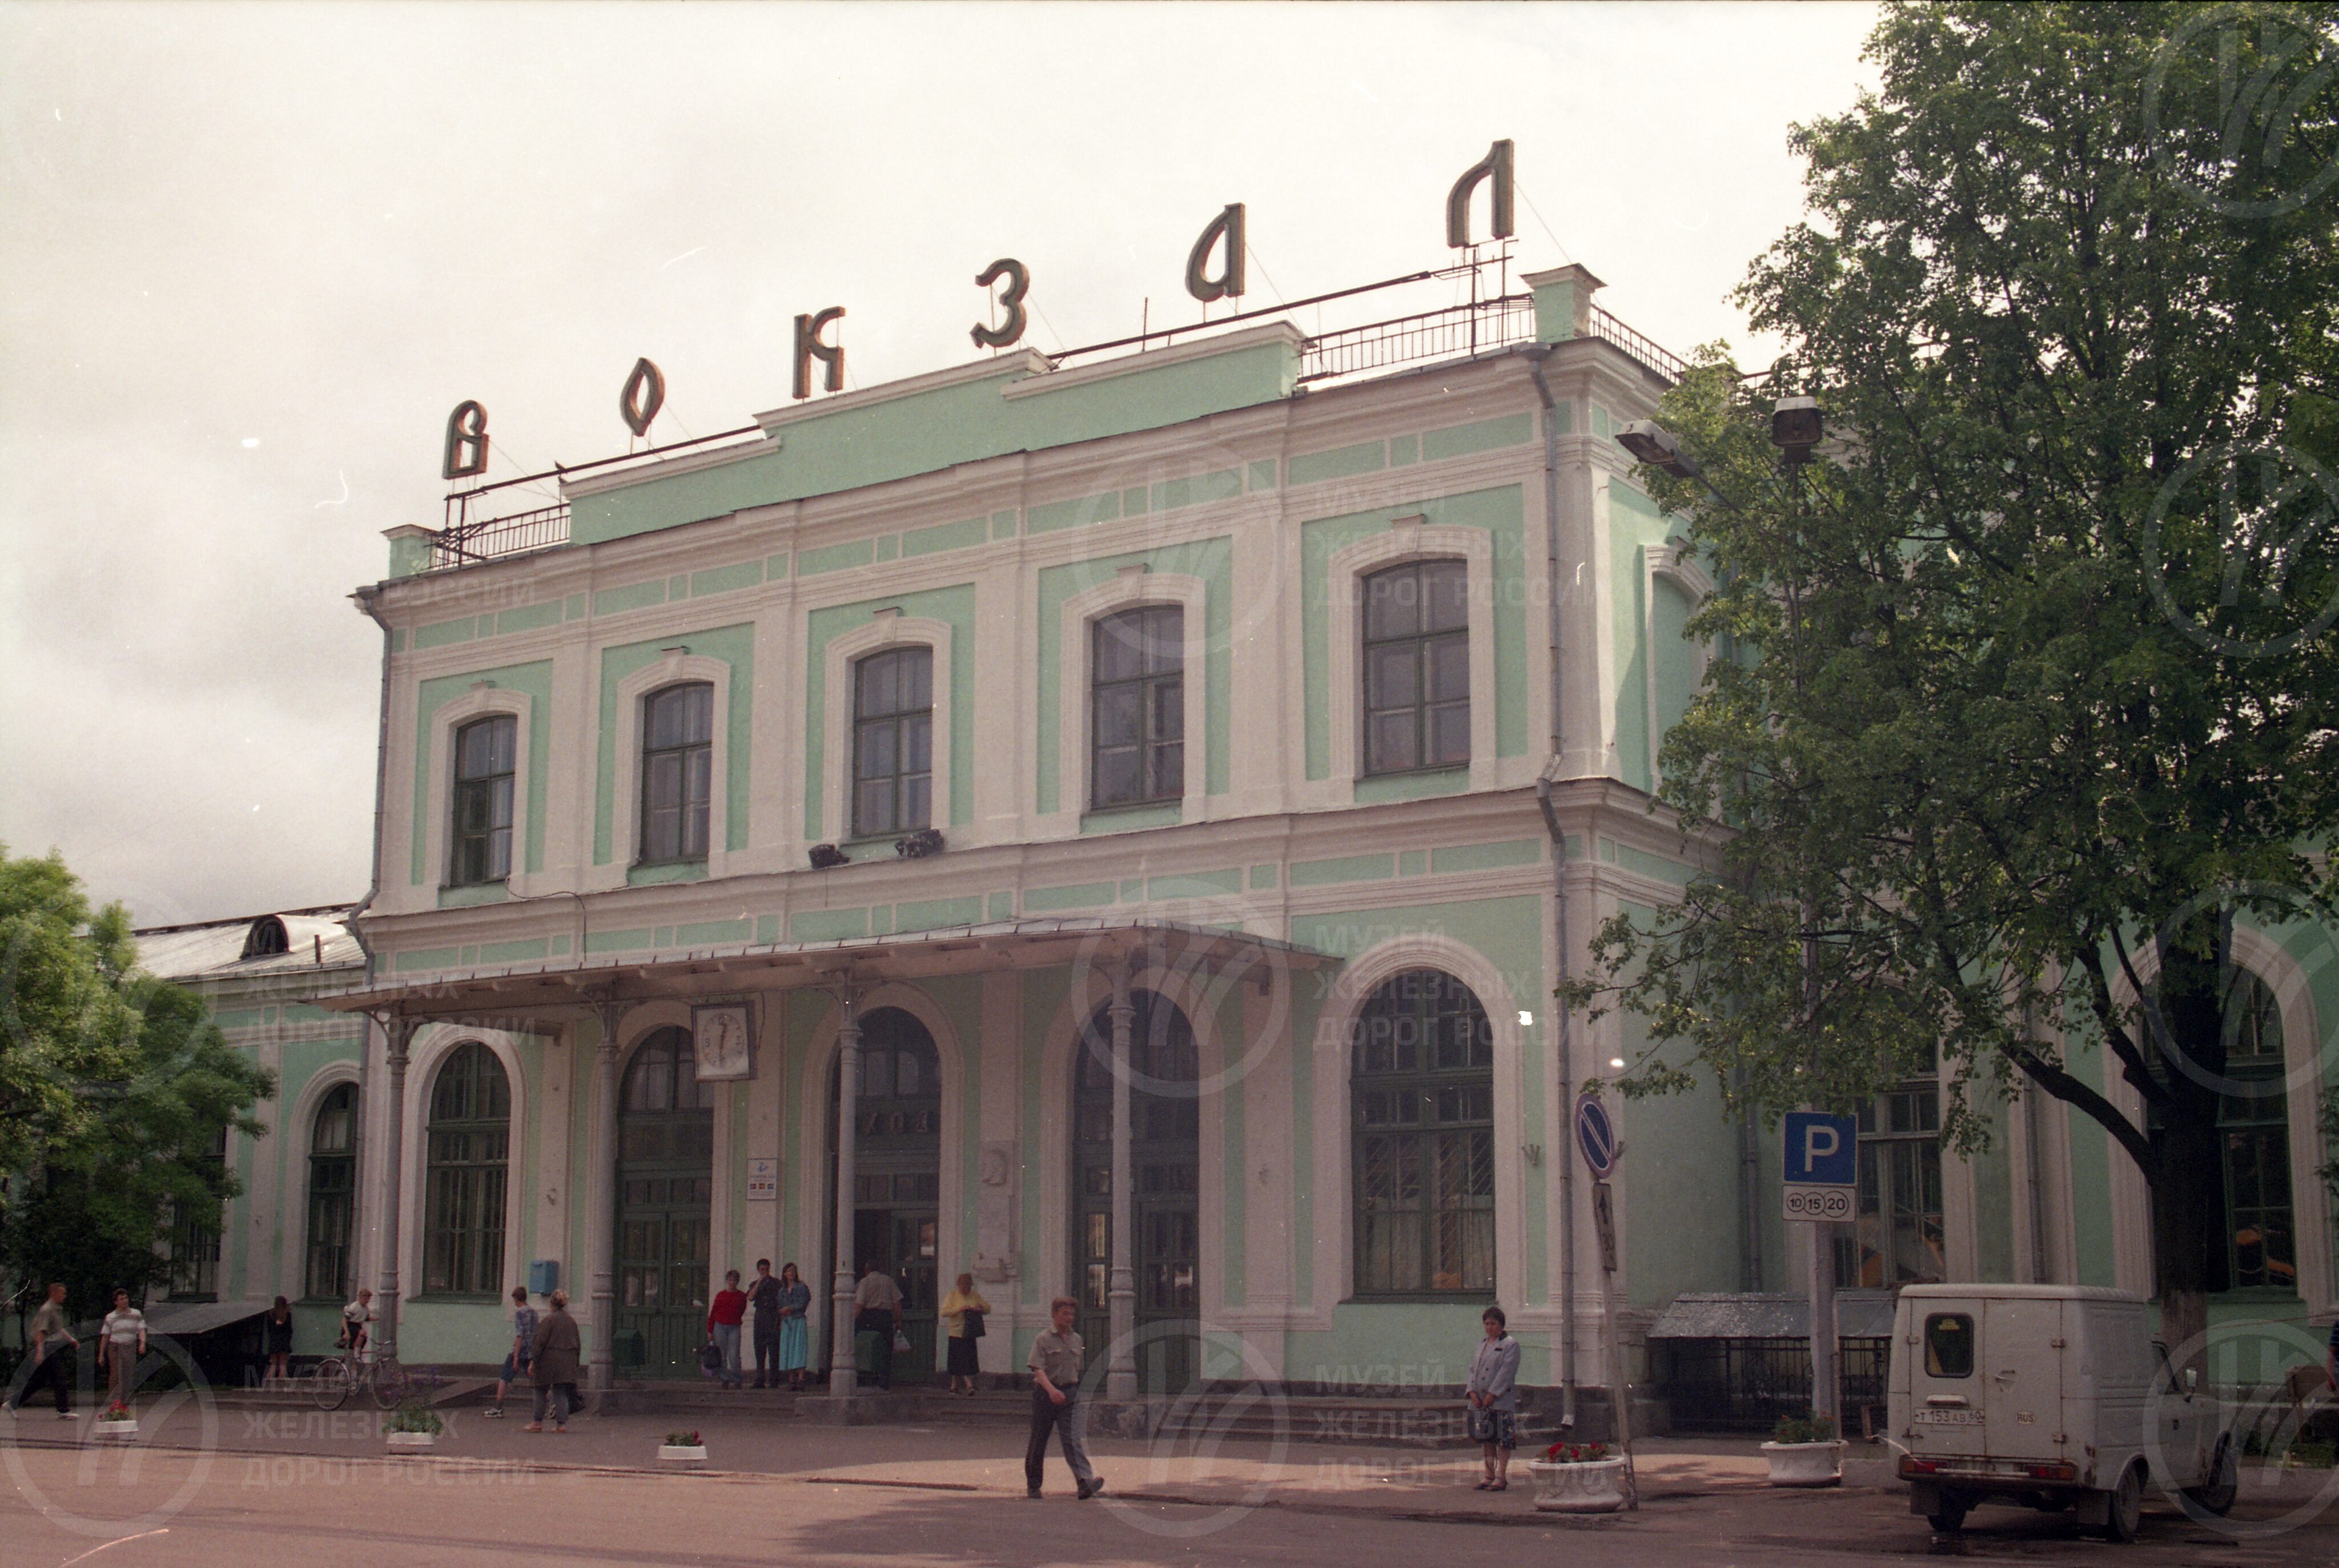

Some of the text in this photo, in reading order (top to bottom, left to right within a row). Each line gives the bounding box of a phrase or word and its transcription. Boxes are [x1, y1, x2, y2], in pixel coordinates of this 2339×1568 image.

[1805, 1125, 1839, 1172] P
[1790, 1198, 1845, 1210] 10 15 20
[1930, 1410, 1950, 1422] 153
[2017, 1413, 2033, 1422] RUS
